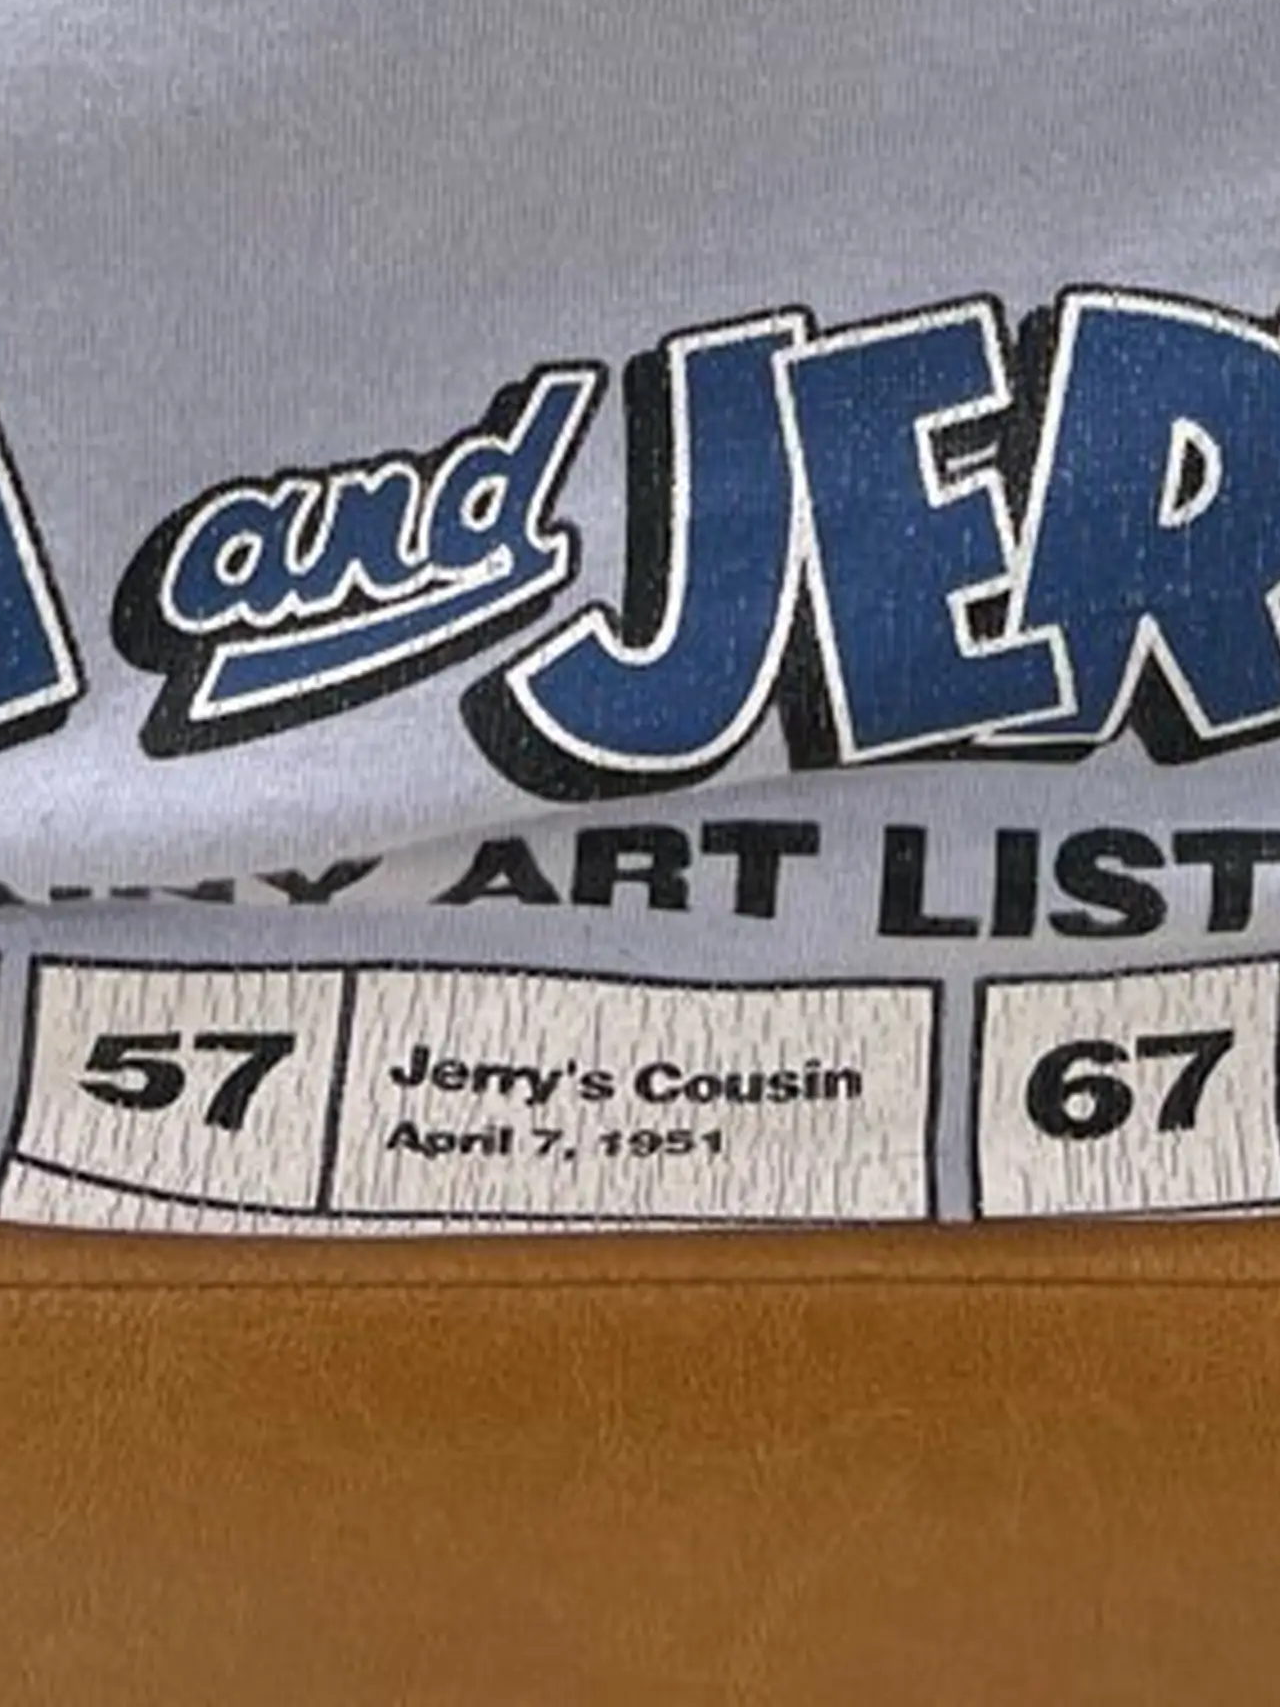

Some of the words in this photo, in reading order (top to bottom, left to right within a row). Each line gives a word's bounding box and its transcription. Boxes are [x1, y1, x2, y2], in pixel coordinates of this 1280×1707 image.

[112, 361, 608, 759] and
[429, 820, 821, 919] ART
[77, 1031, 296, 1132] 57
[389, 1044, 615, 1107] Jerry's
[633, 1058, 864, 1105] Cousin
[1022, 1028, 1237, 1141] 67
[385, 1119, 514, 1160] April
[531, 1127, 577, 1161] 7,
[599, 1127, 724, 1158] 1951
